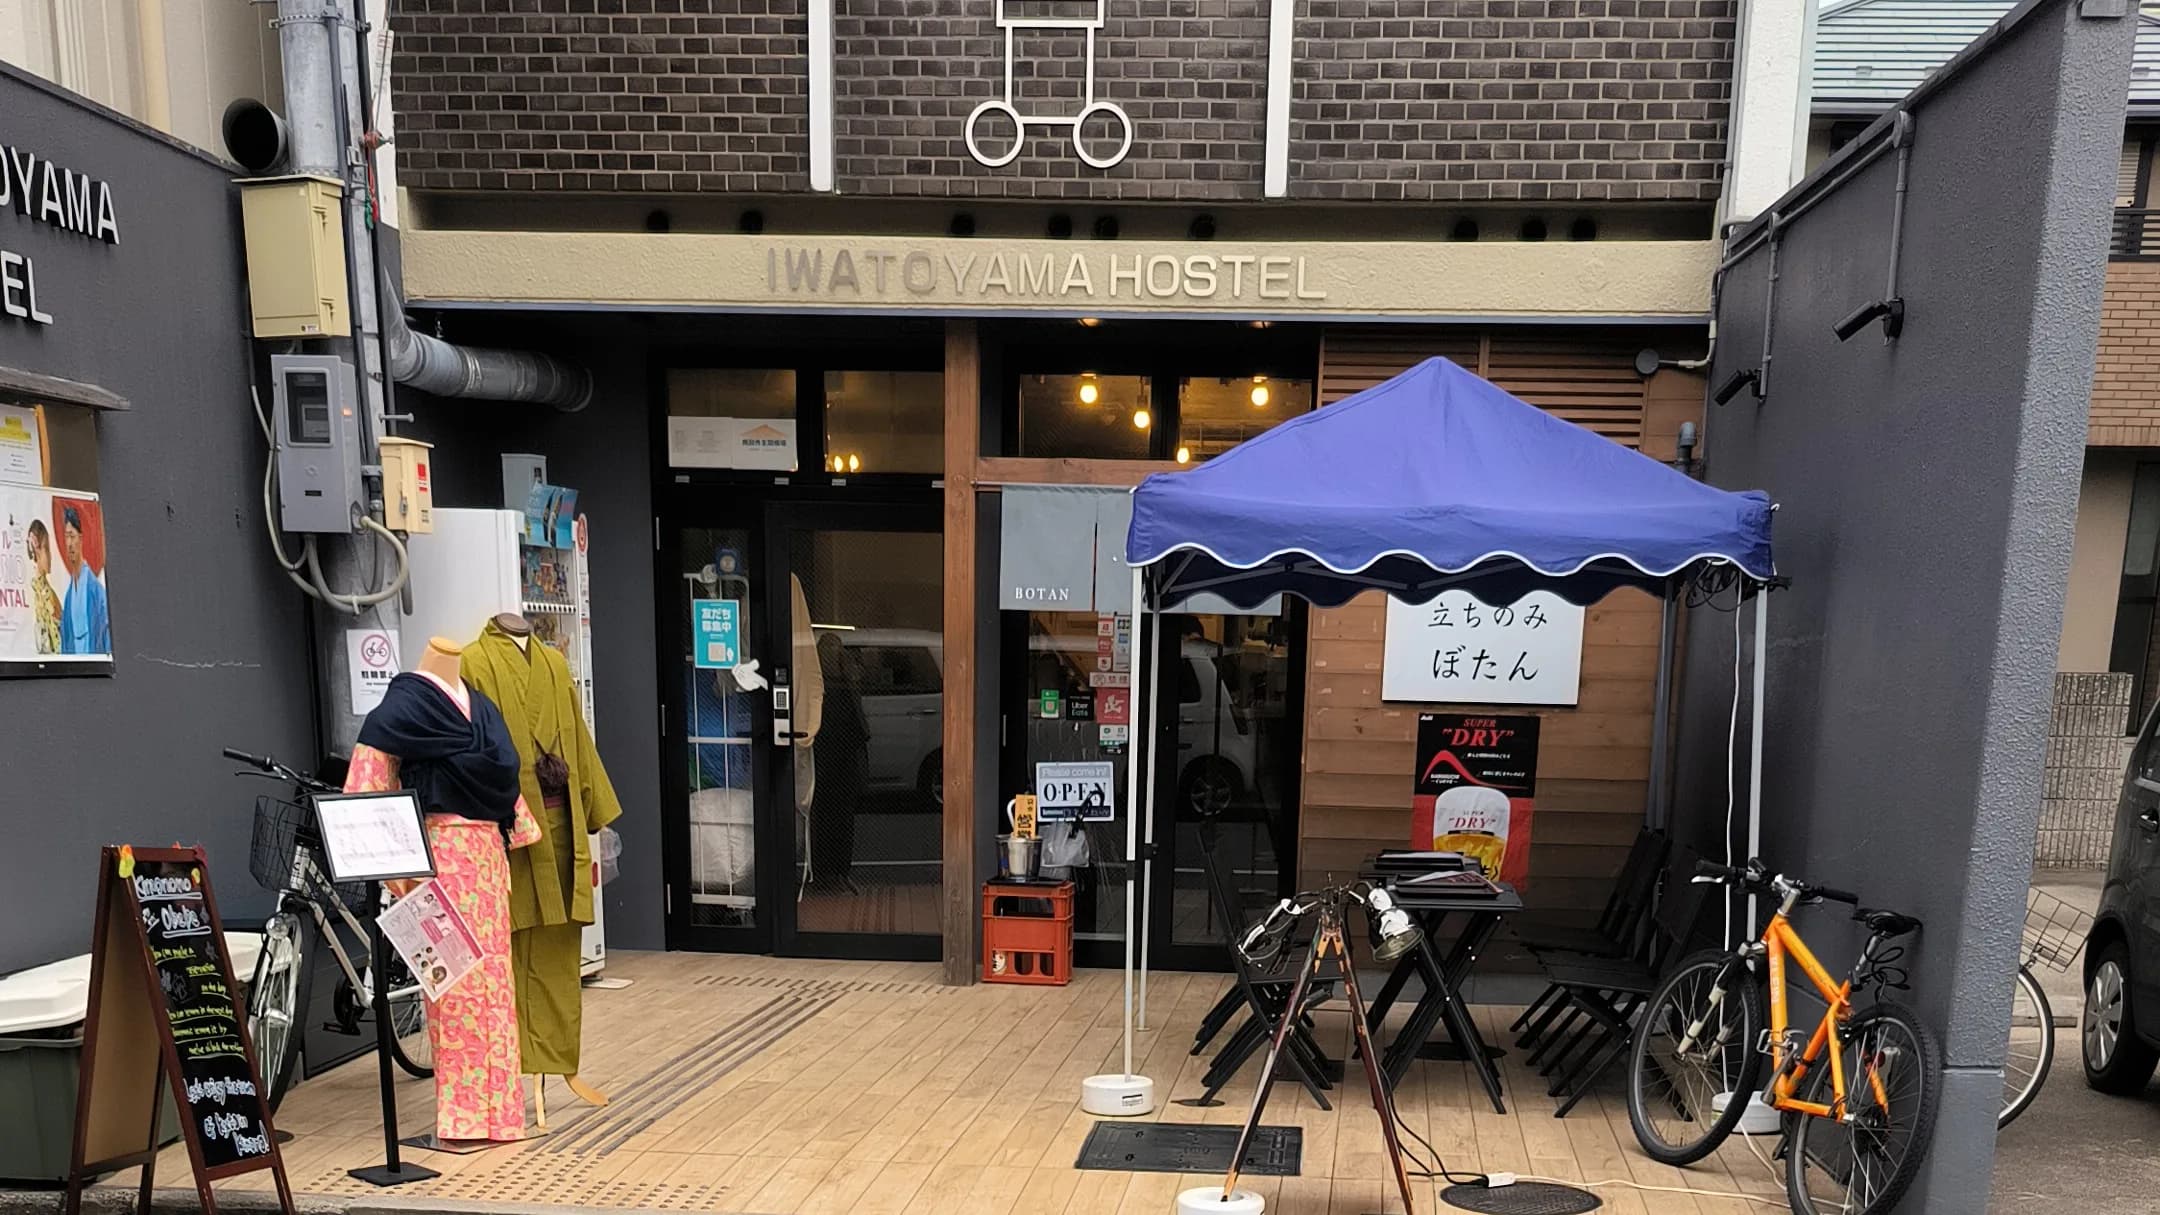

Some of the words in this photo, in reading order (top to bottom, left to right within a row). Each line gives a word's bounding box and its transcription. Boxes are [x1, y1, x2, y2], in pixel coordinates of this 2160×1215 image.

[766, 246, 1095, 296] IWATOYAMA
[1109, 253, 1327, 299] HOSTEL
[1015, 587, 1070, 601] BOTAN
[1428, 601, 1548, 629] 立ちのみ
[1432, 644, 1539, 682] ぼたん
[1072, 709, 1088, 717] Eats
[1463, 719, 1497, 728] SUPER
